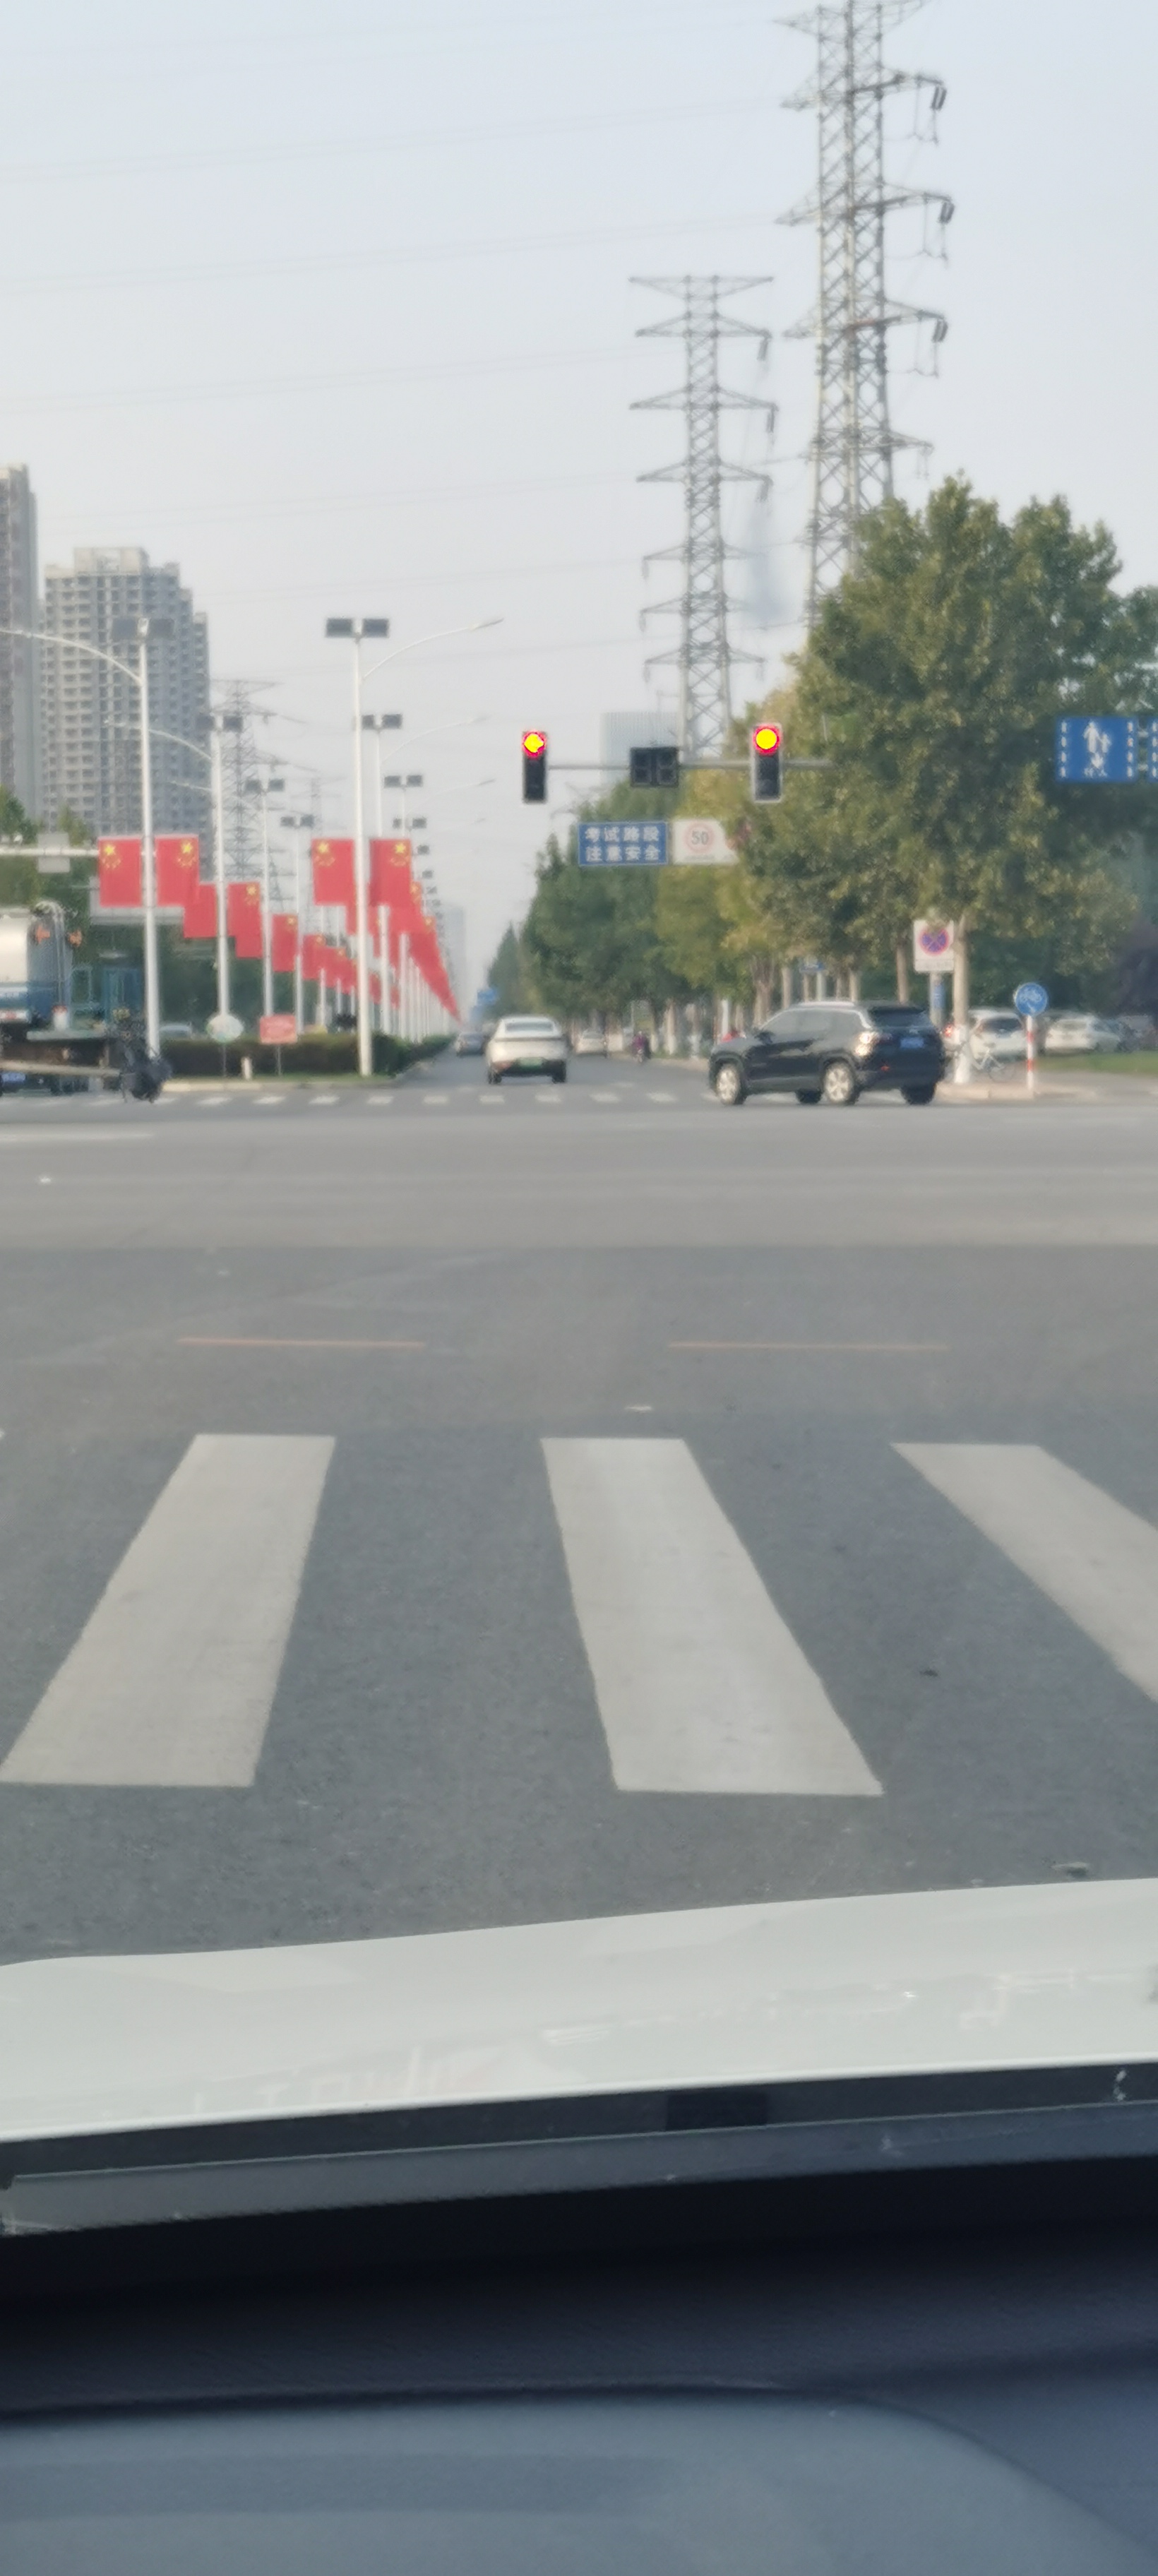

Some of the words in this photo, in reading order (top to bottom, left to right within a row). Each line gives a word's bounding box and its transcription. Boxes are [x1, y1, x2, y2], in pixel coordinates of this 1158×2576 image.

[585, 826, 659, 842] 考试路段
[691, 830, 709, 845] 50
[585, 845, 661, 862] 注意安全
